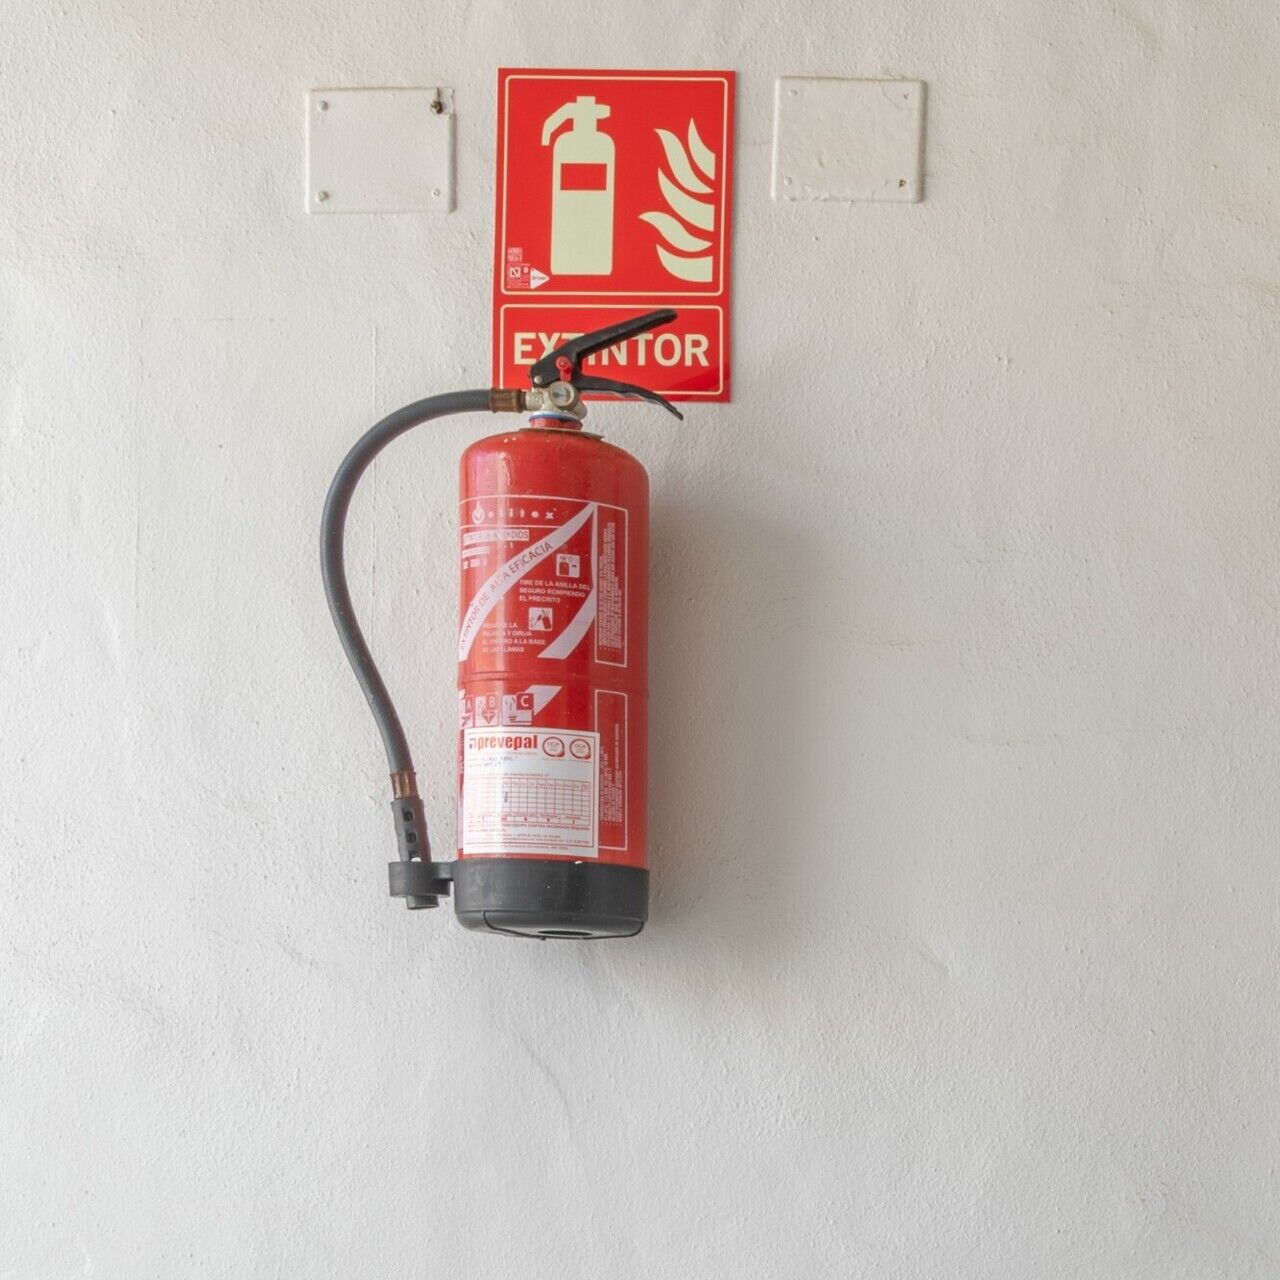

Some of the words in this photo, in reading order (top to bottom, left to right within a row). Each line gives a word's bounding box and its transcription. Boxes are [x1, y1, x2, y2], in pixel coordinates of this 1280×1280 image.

[513, 331, 710, 367] EXNTOR
[508, 541, 554, 574] EFICACIA
[578, 583, 591, 591] DEL
[546, 588, 585, 598] ROMPIENDO
[489, 696, 496, 707] B
[521, 696, 529, 707] C
[476, 735, 538, 751] prevepal
